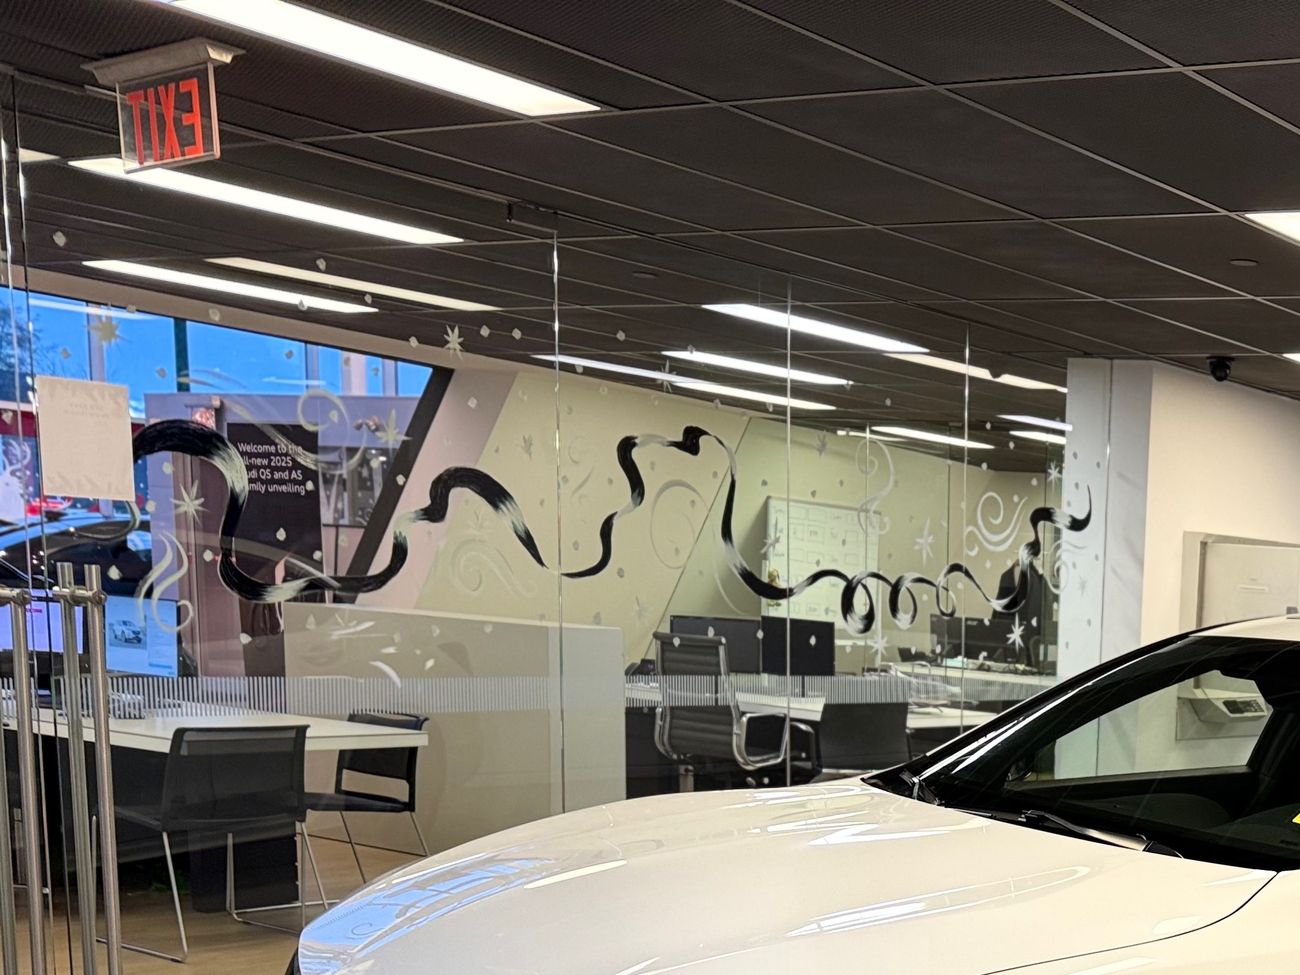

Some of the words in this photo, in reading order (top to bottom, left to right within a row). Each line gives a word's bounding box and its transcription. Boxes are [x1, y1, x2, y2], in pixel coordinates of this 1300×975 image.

[238, 442, 276, 453] Welcome
[277, 443, 287, 453] to
[288, 445, 303, 453] the
[243, 456, 268, 466] ll-new
[270, 456, 292, 467] 2025
[273, 470, 289, 479] and
[267, 483, 305, 496] unveiling
